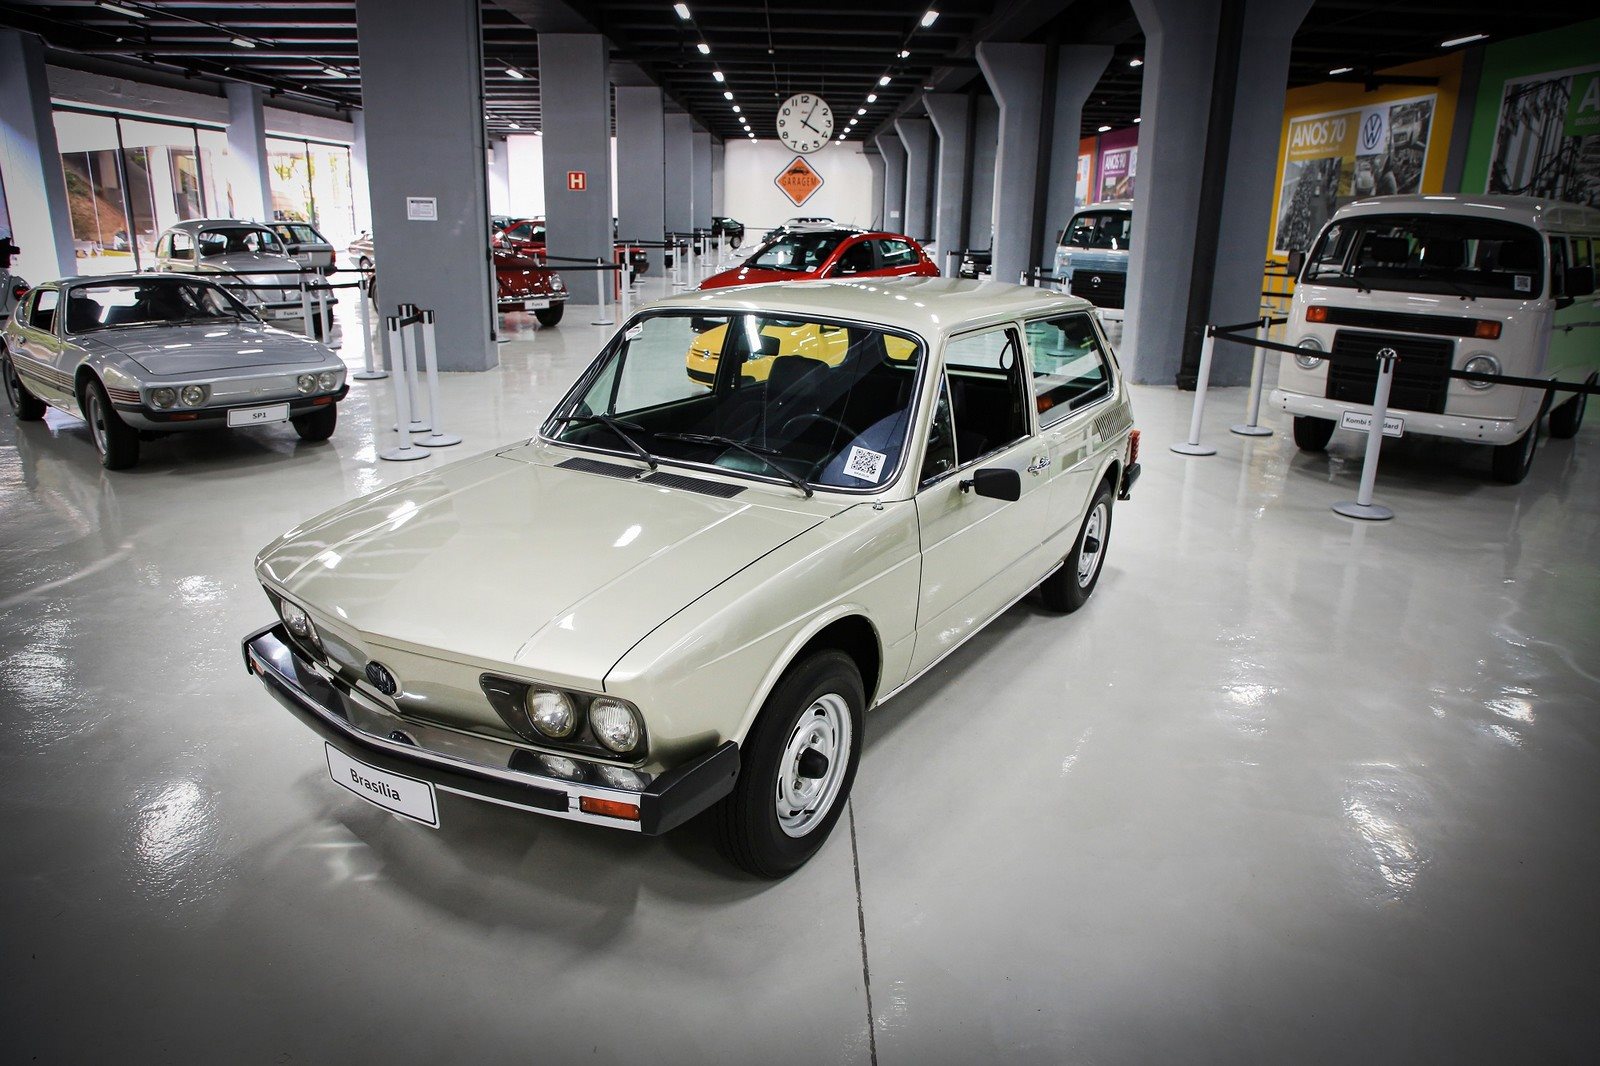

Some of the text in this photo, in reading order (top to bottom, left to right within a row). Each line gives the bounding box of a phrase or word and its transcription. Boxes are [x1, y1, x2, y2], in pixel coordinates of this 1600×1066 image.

[792, 98, 798, 106] 11
[801, 95, 810, 104] 12
[782, 108, 790, 116] 10
[822, 108, 828, 116] 2
[826, 120, 832, 128] 3
[782, 131, 788, 139] 8
[1291, 117, 1346, 148] ANOS 70
[782, 176, 817, 187] GARAGEM
[1346, 416, 1399, 430] Kombi Sdard
[350, 767, 402, 802] Brasília
